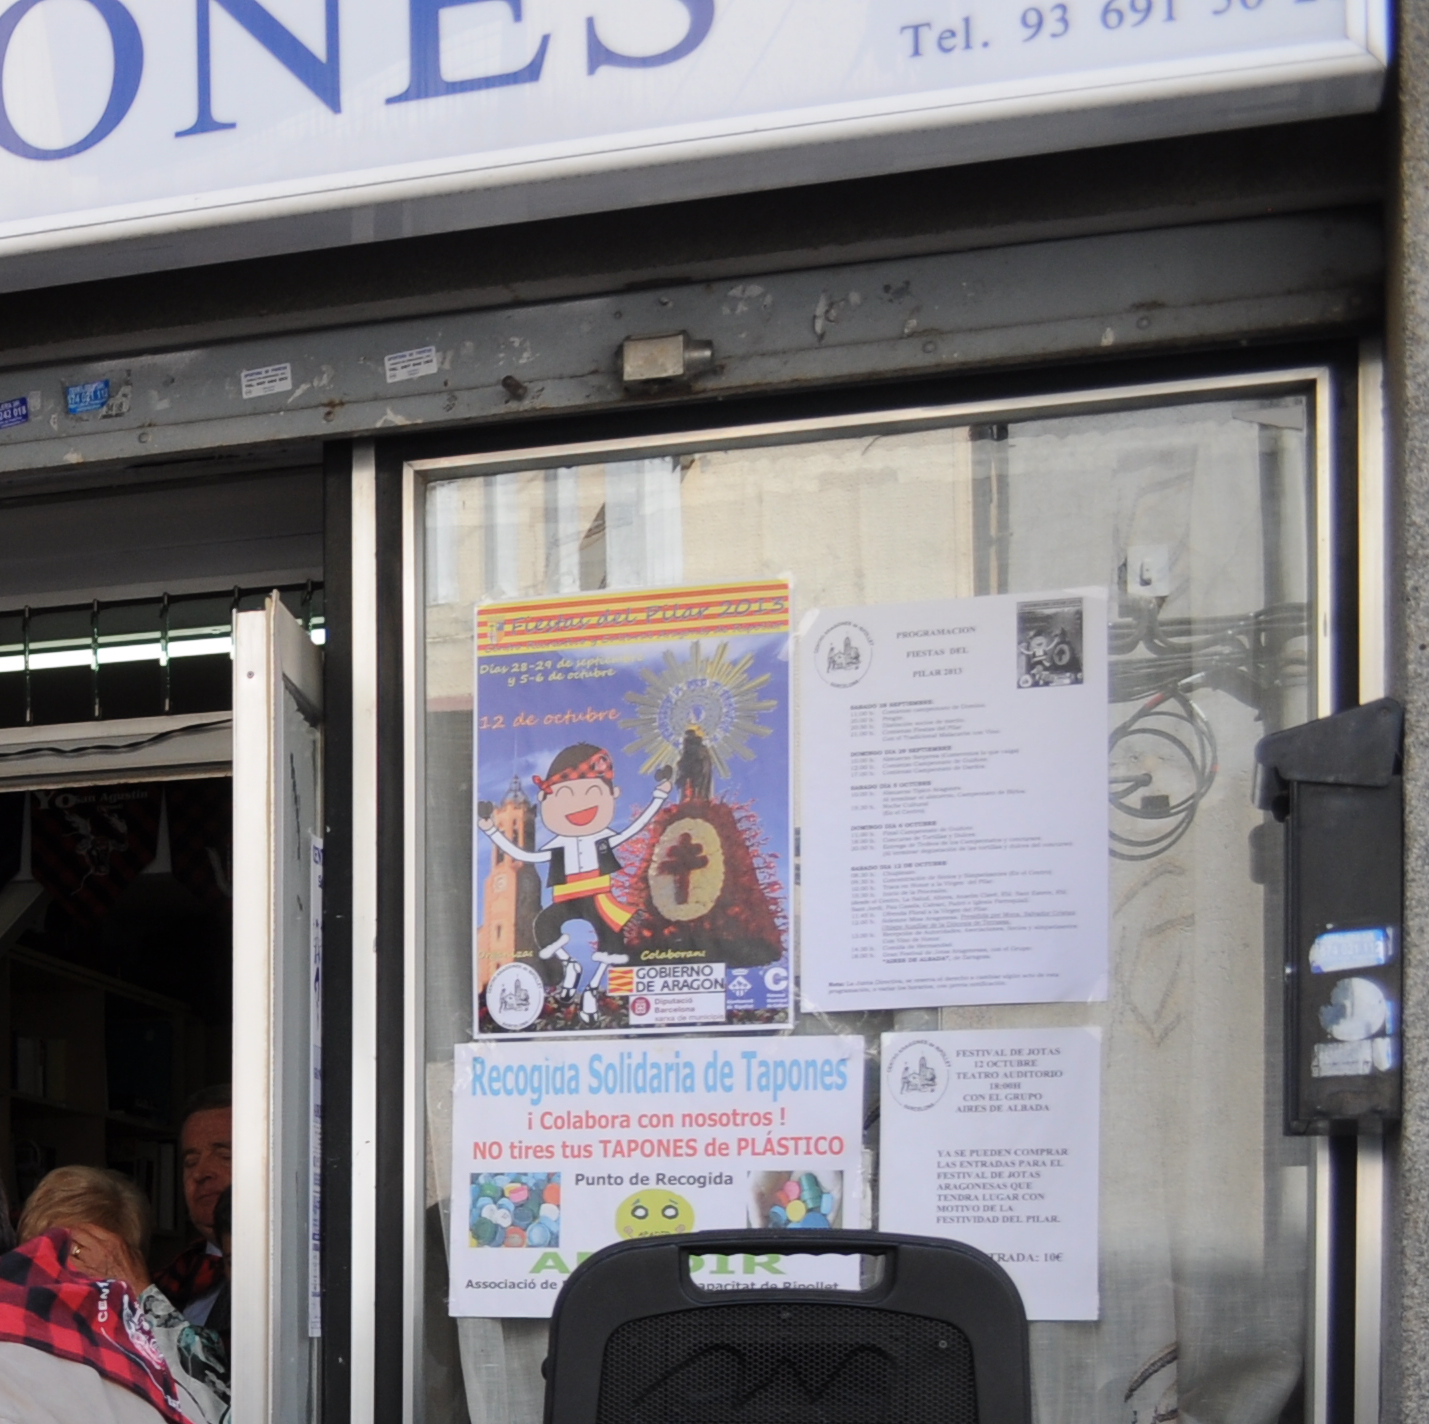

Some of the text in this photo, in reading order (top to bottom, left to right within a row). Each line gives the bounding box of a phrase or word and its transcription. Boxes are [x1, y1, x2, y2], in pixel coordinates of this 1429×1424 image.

[900, 16, 990, 58] Tel.
[1020, 3, 1070, 43] 93
[512, 596, 785, 635] Fiestas del Pilar 2013
[896, 626, 977, 639] PROGRAMACION
[906, 647, 969, 659] FIESTAS DEL
[511, 660, 553, 674] 28-29
[557, 658, 573, 669] de
[548, 671, 566, 681] de
[567, 667, 617, 680] octubre
[912, 668, 941, 678] PILAR
[479, 705, 622, 731] 12 de octubre
[636, 965, 713, 979] GOBIERNO
[636, 977, 725, 993] DE ARAGON
[956, 1047, 1062, 1058] FESTIVAL DE JOTAS
[974, 1059, 1038, 1068] 12 OCTUBRE
[470, 1050, 848, 1105] Recogida Solidaria de Tapones
[956, 1069, 1064, 1080] TEATRO AUDITORIO
[963, 1092, 1043, 1102] CON EL GRUPO
[955, 1103, 1050, 1113] AIRES DE ALBADA
[540, 1110, 632, 1131] Colabora
[637, 1113, 674, 1129] con
[681, 1110, 773, 1129] nosotros
[472, 1131, 844, 1161] NO tires tus TAPONES de PLÁSTICO
[937, 1148, 1069, 1157] YA SE PUEDEN COMPRAR
[937, 1159, 1064, 1169] LAS ENTRADAS PARA EL
[574, 1172, 734, 1189] Punto de Recogida
[936, 1170, 1041, 1180] FESTIVAL DE JOTAS
[936, 1182, 1033, 1191] ARAGONESAS QUE
[936, 1192, 1045, 1202] TENDRA LUGAR CON
[936, 1204, 1014, 1213] MOTIVO DE LA
[936, 1215, 1000, 1224] FESTIVIDAD
[1002, 1215, 1023, 1223] DEL
[991, 1252, 1063, 1263] TRADA: 10€
[465, 1278, 536, 1291] Associació
[540, 1278, 558, 1291] de
[760, 1280, 777, 1291] de
